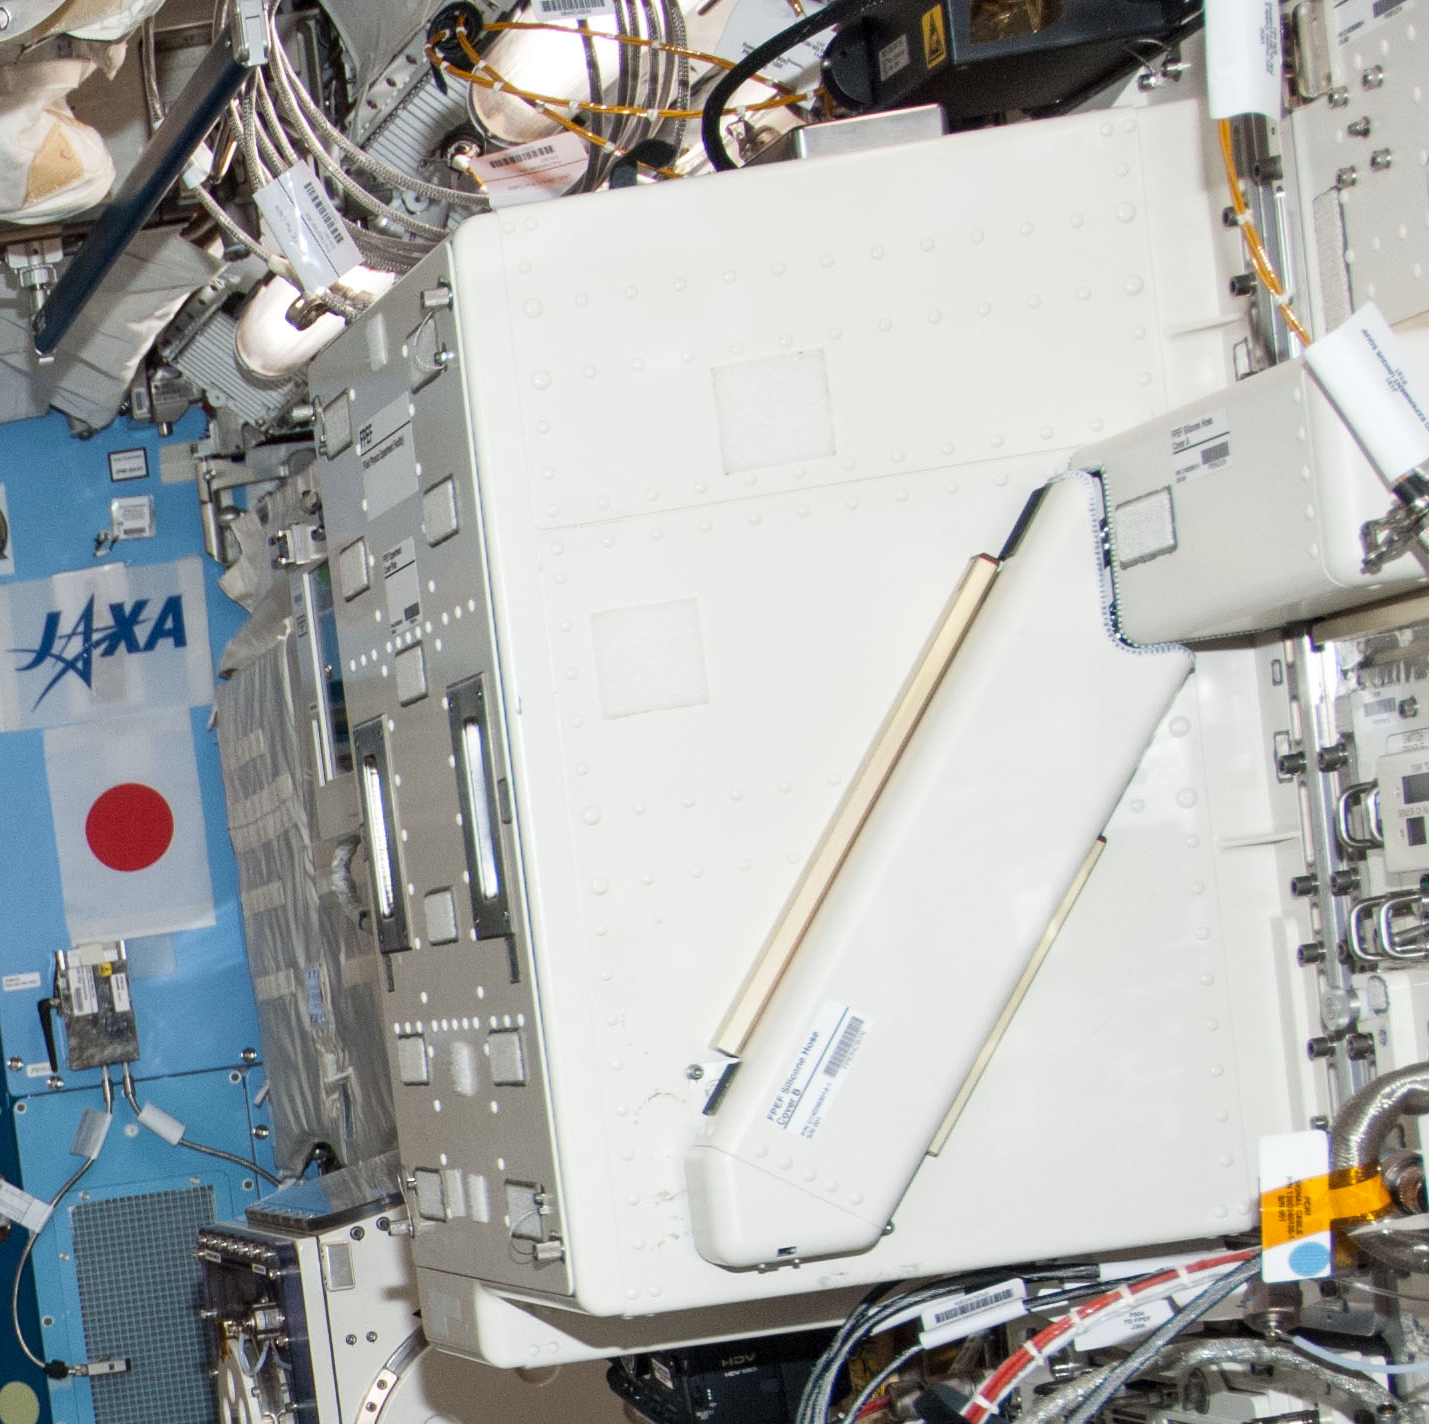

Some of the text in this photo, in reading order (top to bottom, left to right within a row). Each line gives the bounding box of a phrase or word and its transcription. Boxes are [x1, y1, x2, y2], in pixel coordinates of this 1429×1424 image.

[7, 594, 188, 712] JAXA
[766, 1031, 820, 1122] FPEF Silicone Hose
[776, 1088, 801, 1125] Cover B
